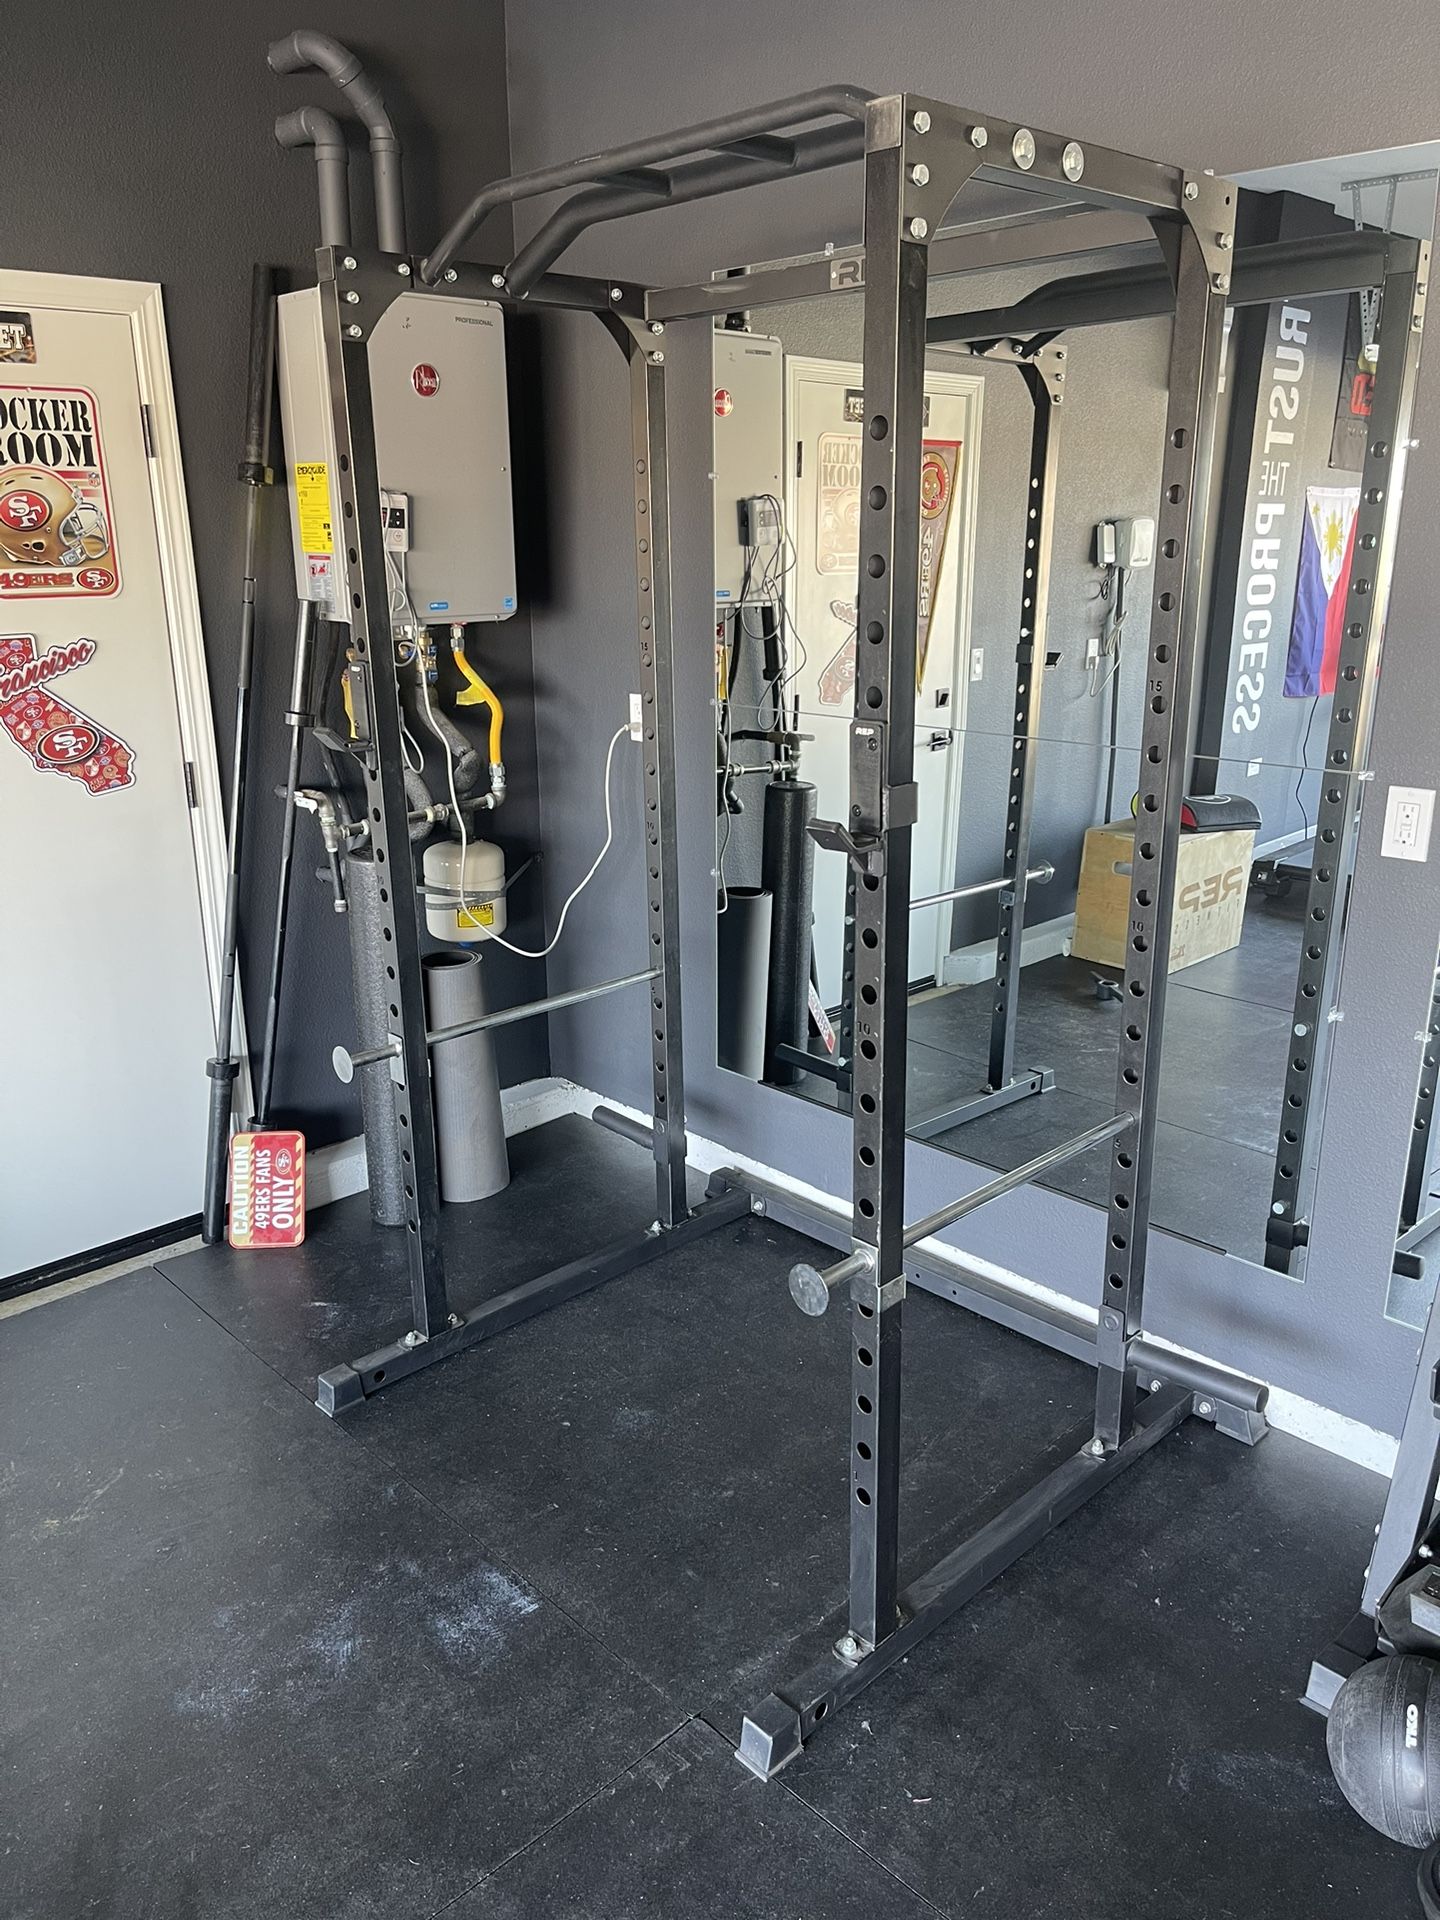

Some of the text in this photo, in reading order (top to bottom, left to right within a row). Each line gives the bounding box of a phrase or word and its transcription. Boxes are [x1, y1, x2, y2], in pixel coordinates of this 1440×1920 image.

[454, 316, 494, 327] PROFESSIONAL
[0, 432, 97, 467] OOM
[1149, 680, 1163, 691] 15
[855, 727, 874, 735] REP
[1132, 920, 1144, 932] 10
[857, 1021, 871, 1035] 10
[232, 1145, 249, 1236] CAUTION
[255, 1149, 271, 1229] 49ERS FANS
[272, 1176, 294, 1229] ONLY
[1406, 1704, 1419, 1748] TKO
